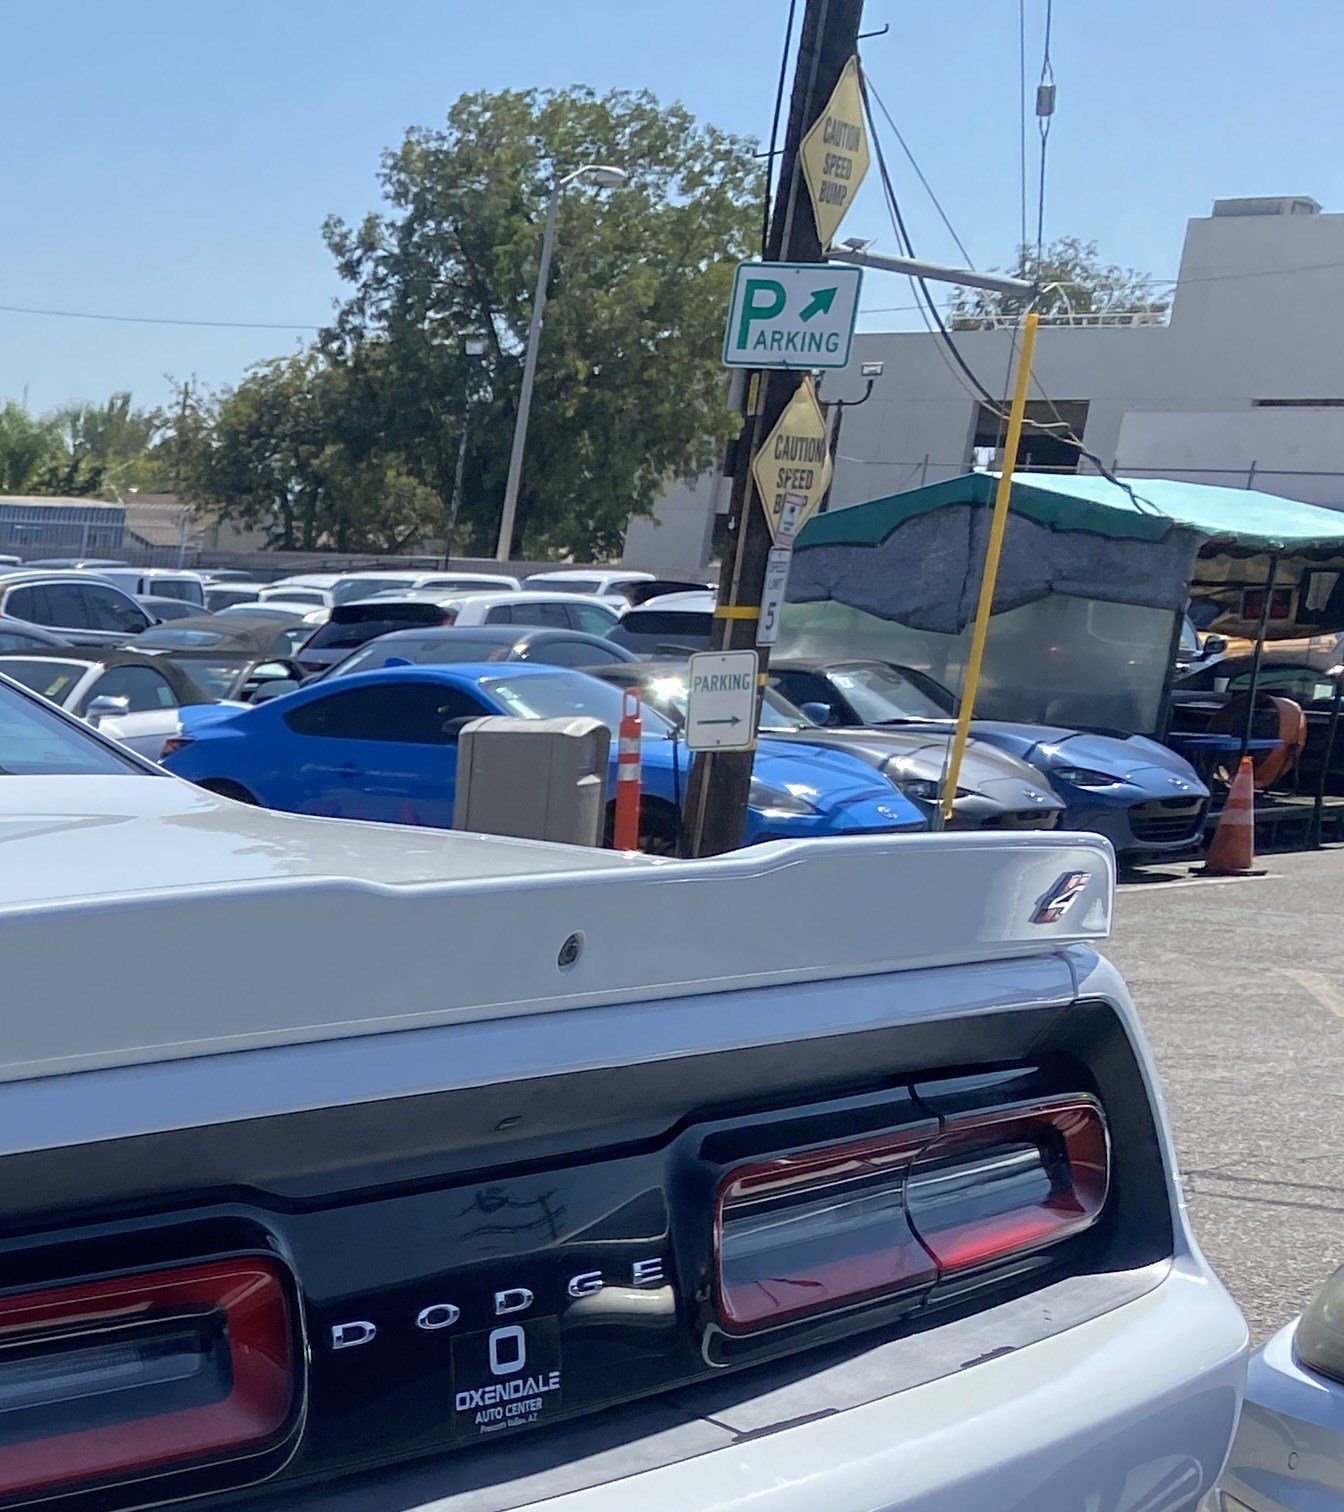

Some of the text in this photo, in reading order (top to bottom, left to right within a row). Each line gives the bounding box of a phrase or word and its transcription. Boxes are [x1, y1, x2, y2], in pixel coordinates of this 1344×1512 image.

[823, 117, 862, 153] CAUTION
[822, 152, 853, 181] SPEED
[818, 180, 848, 206] BUMP
[736, 279, 840, 353] PARKING
[774, 434, 827, 468] CAUTION
[776, 467, 814, 490] SPEED
[765, 601, 777, 631] 5
[693, 673, 751, 693] PARKING
[331, 1257, 665, 1351] DODGE
[455, 1370, 561, 1411] OXENDALE
[475, 1406, 504, 1424] AUTO
[505, 1397, 543, 1417] CENTER
